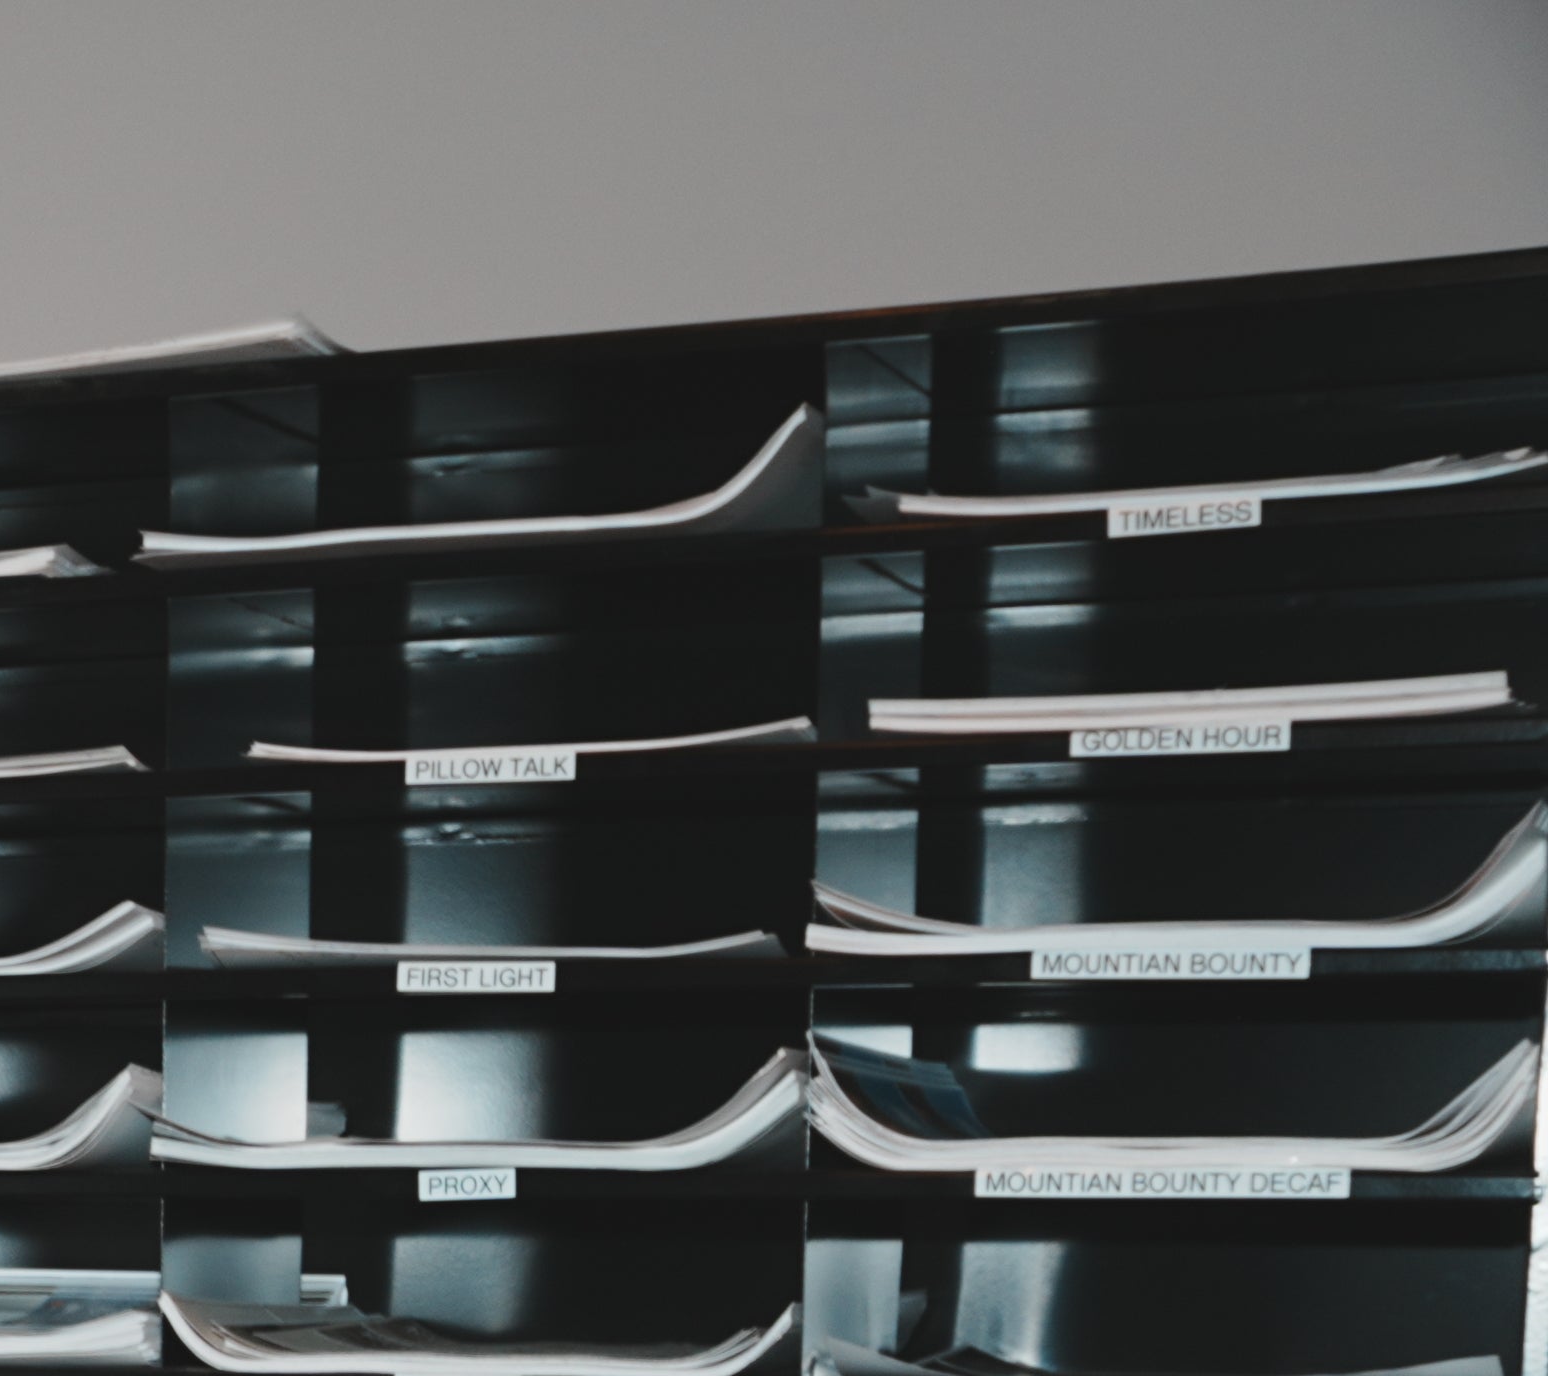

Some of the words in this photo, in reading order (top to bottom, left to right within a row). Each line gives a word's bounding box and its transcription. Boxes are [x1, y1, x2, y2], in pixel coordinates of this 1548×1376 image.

[1120, 501, 1254, 532] TIMELESS
[1080, 728, 1192, 753] GOLDEN
[1202, 724, 1283, 750] HOUR
[415, 759, 502, 781] PILLOW
[511, 757, 569, 778] TALK
[1042, 952, 1180, 975] MOUNTIAN
[1189, 951, 1302, 974] BOUNTY
[406, 968, 471, 989] FIRST
[479, 967, 549, 988] LIGHT
[428, 1175, 509, 1196] PROXY
[985, 1172, 1122, 1194] MOUNTIAN
[1131, 1172, 1240, 1194] BOUNTY
[1250, 1172, 1343, 1194] DECAF
